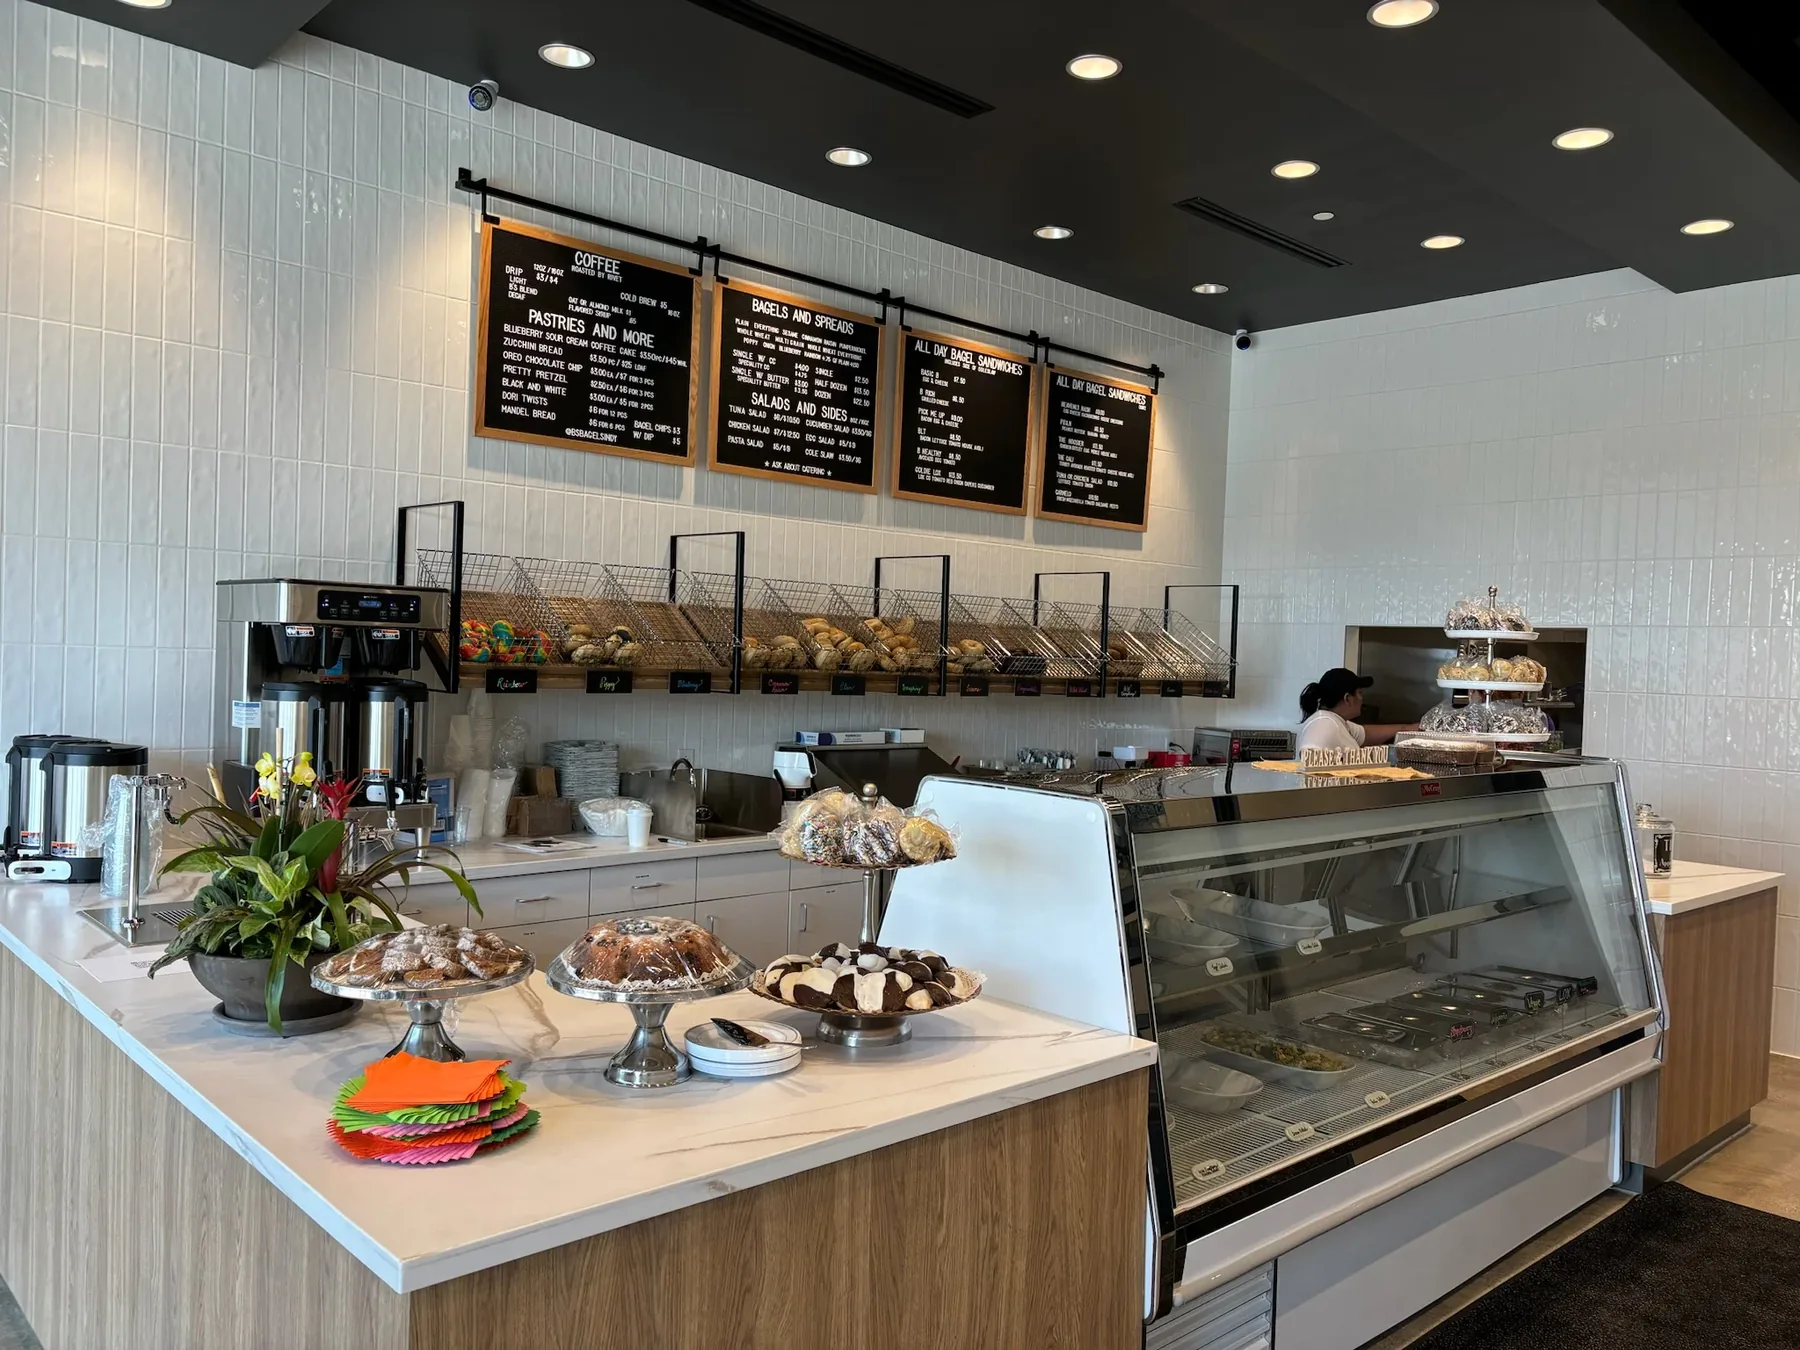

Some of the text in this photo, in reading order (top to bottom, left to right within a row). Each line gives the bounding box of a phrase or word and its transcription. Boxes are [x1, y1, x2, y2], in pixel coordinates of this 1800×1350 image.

[506, 265, 523, 276] DRIP
[575, 251, 620, 275] COFFEE
[510, 275, 527, 285] LIGHT
[571, 265, 595, 276] ROASTED
[607, 274, 622, 283] RIVET
[508, 291, 525, 300] DECAF
[519, 283, 538, 295] BLEND
[568, 296, 578, 304] OAT
[589, 302, 609, 311] ALMOND
[612, 306, 623, 314] MILK
[620, 292, 668, 309] COLD BREW $5
[568, 304, 611, 318] FLAVORED SYRUP
[752, 298, 854, 335] BAGELS AND SPREADS
[529, 309, 654, 348] PASTRIES AND MORE
[735, 318, 749, 327] PLAIN
[754, 322, 779, 334] EVERYTHING
[782, 329, 798, 338] SESAME
[801, 334, 822, 344] CINNAMON
[839, 343, 866, 354] PUMPERNICKEL
[503, 337, 563, 356] ZUCCHINI BREAD
[504, 324, 636, 357] BLUEBERRY SOUR CREAM COFFEE CAKE
[737, 327, 753, 336] WHOLE
[754, 331, 770, 340] WHEAT
[808, 344, 821, 352] WHOLE
[837, 350, 862, 361] EVERYTHING
[743, 337, 758, 346] POPPY
[763, 342, 775, 350] ONION
[779, 345, 801, 355] BLUEBERRY
[503, 351, 583, 372] OREO CHOCOLATE CHIP
[733, 349, 753, 360] SINGLE
[915, 340, 1022, 376] ALL DAY BAGEL SANDWICHES
[503, 364, 568, 383] PRETTY PRETZEL
[732, 366, 752, 377] SINGLE
[767, 373, 789, 384] BUTTER
[815, 367, 833, 377] SINGLE
[502, 377, 566, 396] BLACK AND WHITE
[764, 380, 781, 389] BUTTER
[815, 378, 847, 391] HALF DOZEN
[1056, 375, 1106, 397] ALL DAY BAGEL
[502, 391, 548, 406] DORI TWISTS
[814, 390, 831, 399] DOZEN
[1108, 388, 1146, 404] SANDWICHES
[501, 405, 556, 420] MANDEL BREAD
[751, 392, 848, 422] SALADS AND SIDES
[634, 420, 653, 431] BAGEL
[655, 424, 672, 433] CHIPS
[729, 404, 850, 434] TUNA SALAD CUCUMBER SALAD
[565, 428, 617, 442] @BSBAGELSINDY
[644, 432, 654, 440] DIP
[728, 420, 835, 445] CHICKEN SALAD EGG SALAD
[728, 435, 834, 459] PASTA SALAD COLE SLAW
[784, 463, 800, 471] ABOUT
[802, 465, 825, 475] CATERING
[1303, 745, 1388, 768] PLEASE & THANK YOU
